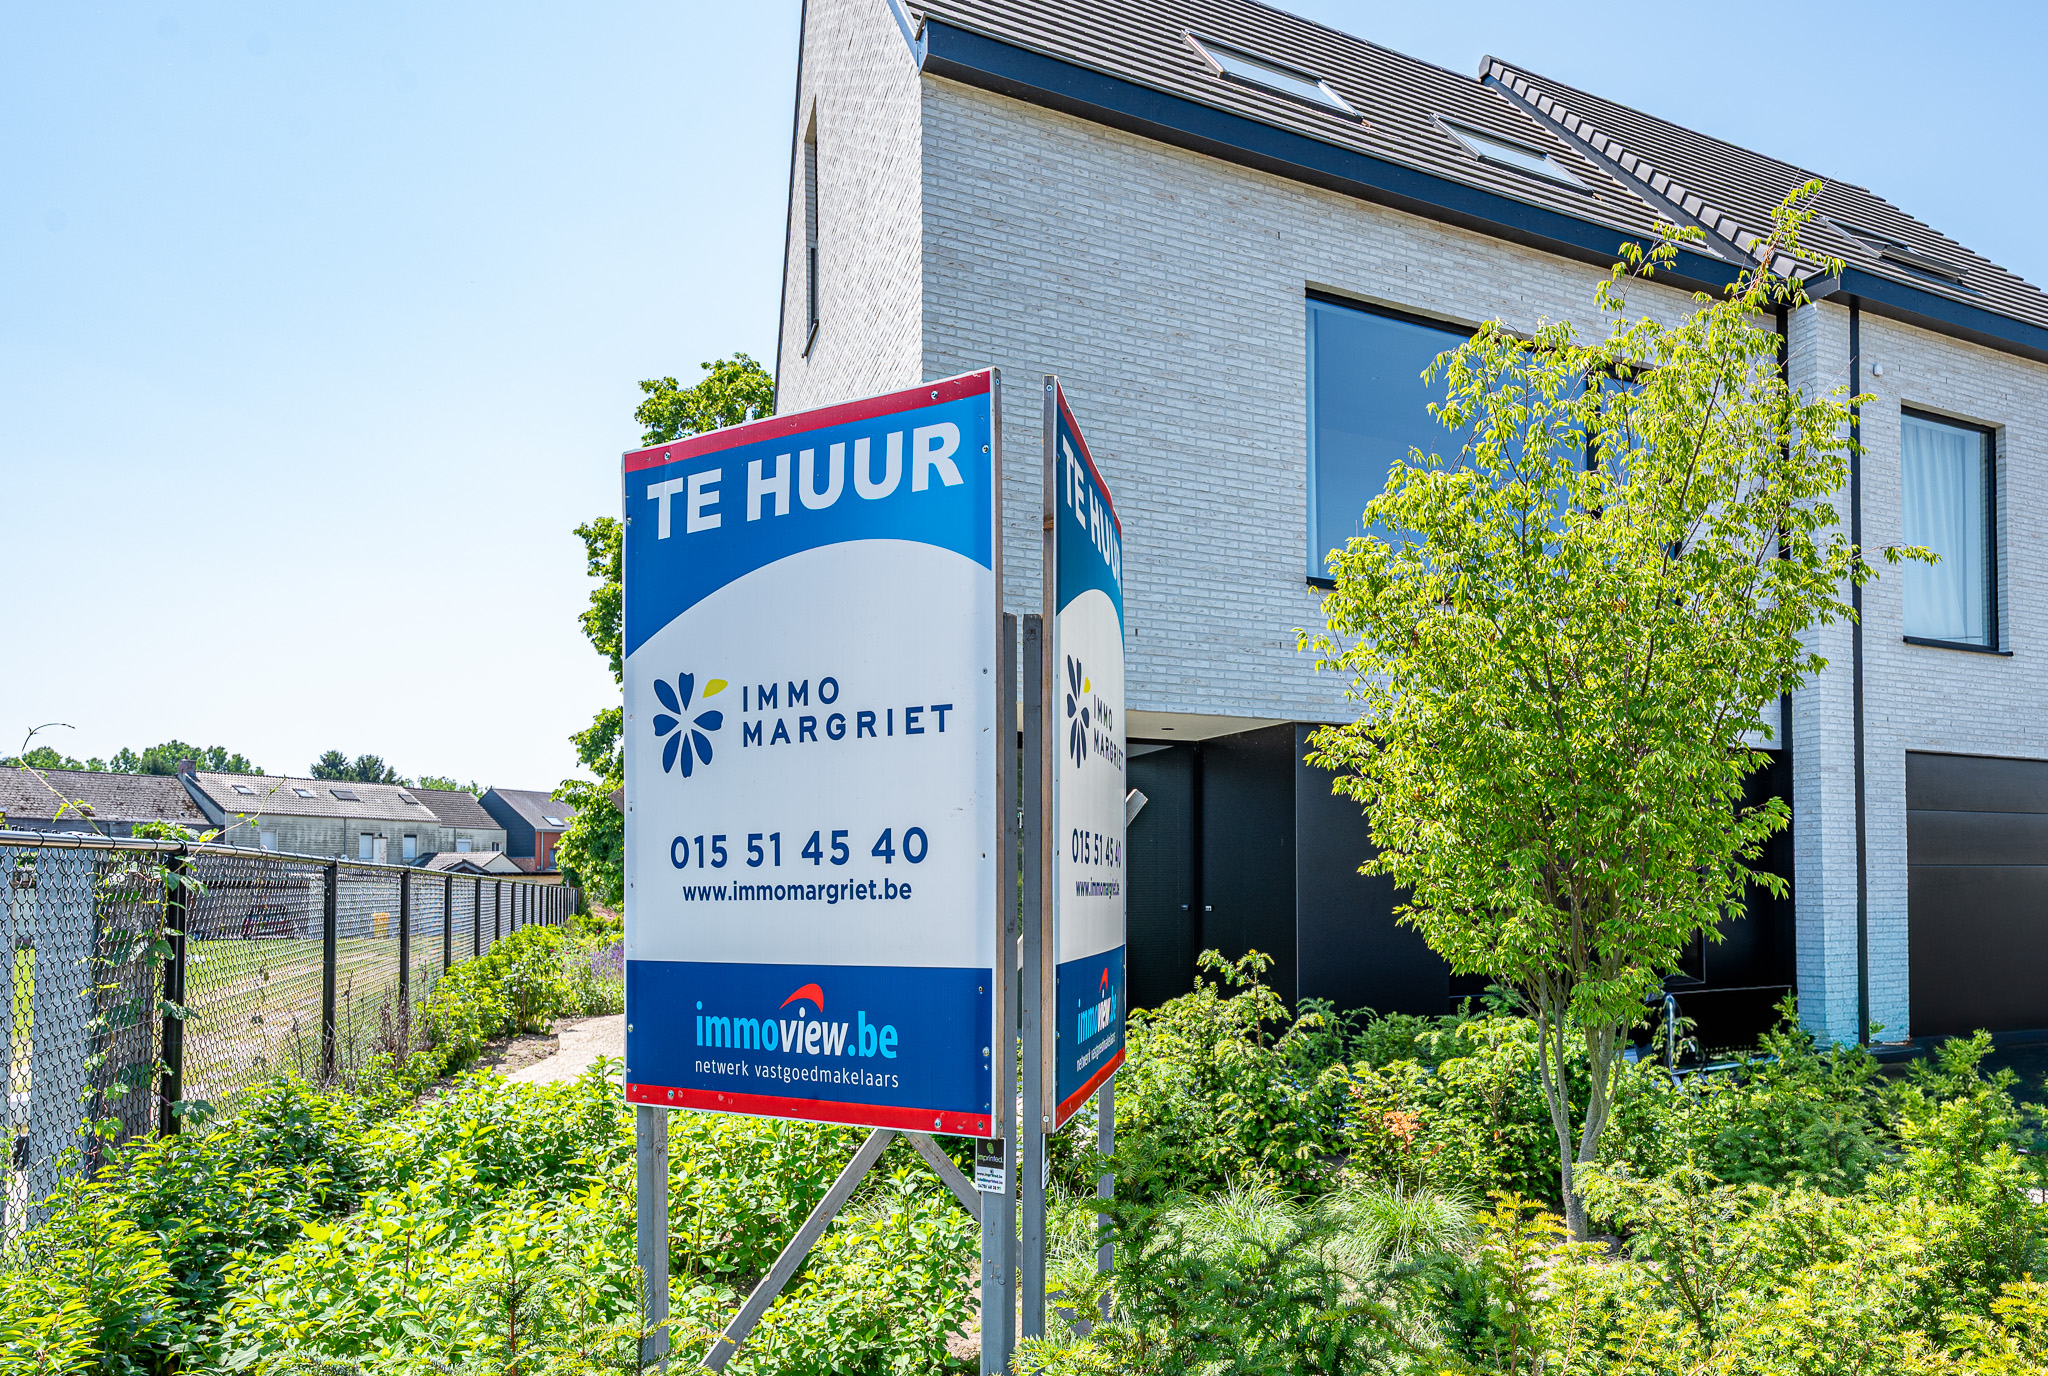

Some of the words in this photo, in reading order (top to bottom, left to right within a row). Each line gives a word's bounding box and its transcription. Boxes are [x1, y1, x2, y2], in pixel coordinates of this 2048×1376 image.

[647, 468, 722, 540] TE
[746, 422, 964, 522] HUUR
[1062, 434, 1087, 530] TE
[743, 676, 839, 712] IMMO
[1093, 694, 1113, 732] IMMO
[743, 703, 953, 747] MARGRIET
[1093, 727, 1124, 773] MARGRIET
[670, 834, 728, 869] 015
[746, 832, 781, 867] 51
[801, 829, 850, 866] 45
[871, 826, 929, 864] 40
[1071, 828, 1091, 865] 015
[1094, 833, 1103, 866] 51
[1105, 836, 1114, 868] 45
[683, 878, 912, 905] www.immomargriet.be
[696, 1000, 899, 1059] immoview.be
[695, 1059, 749, 1077] netwerk
[754, 1064, 899, 1088] vastgoedmakelaars
